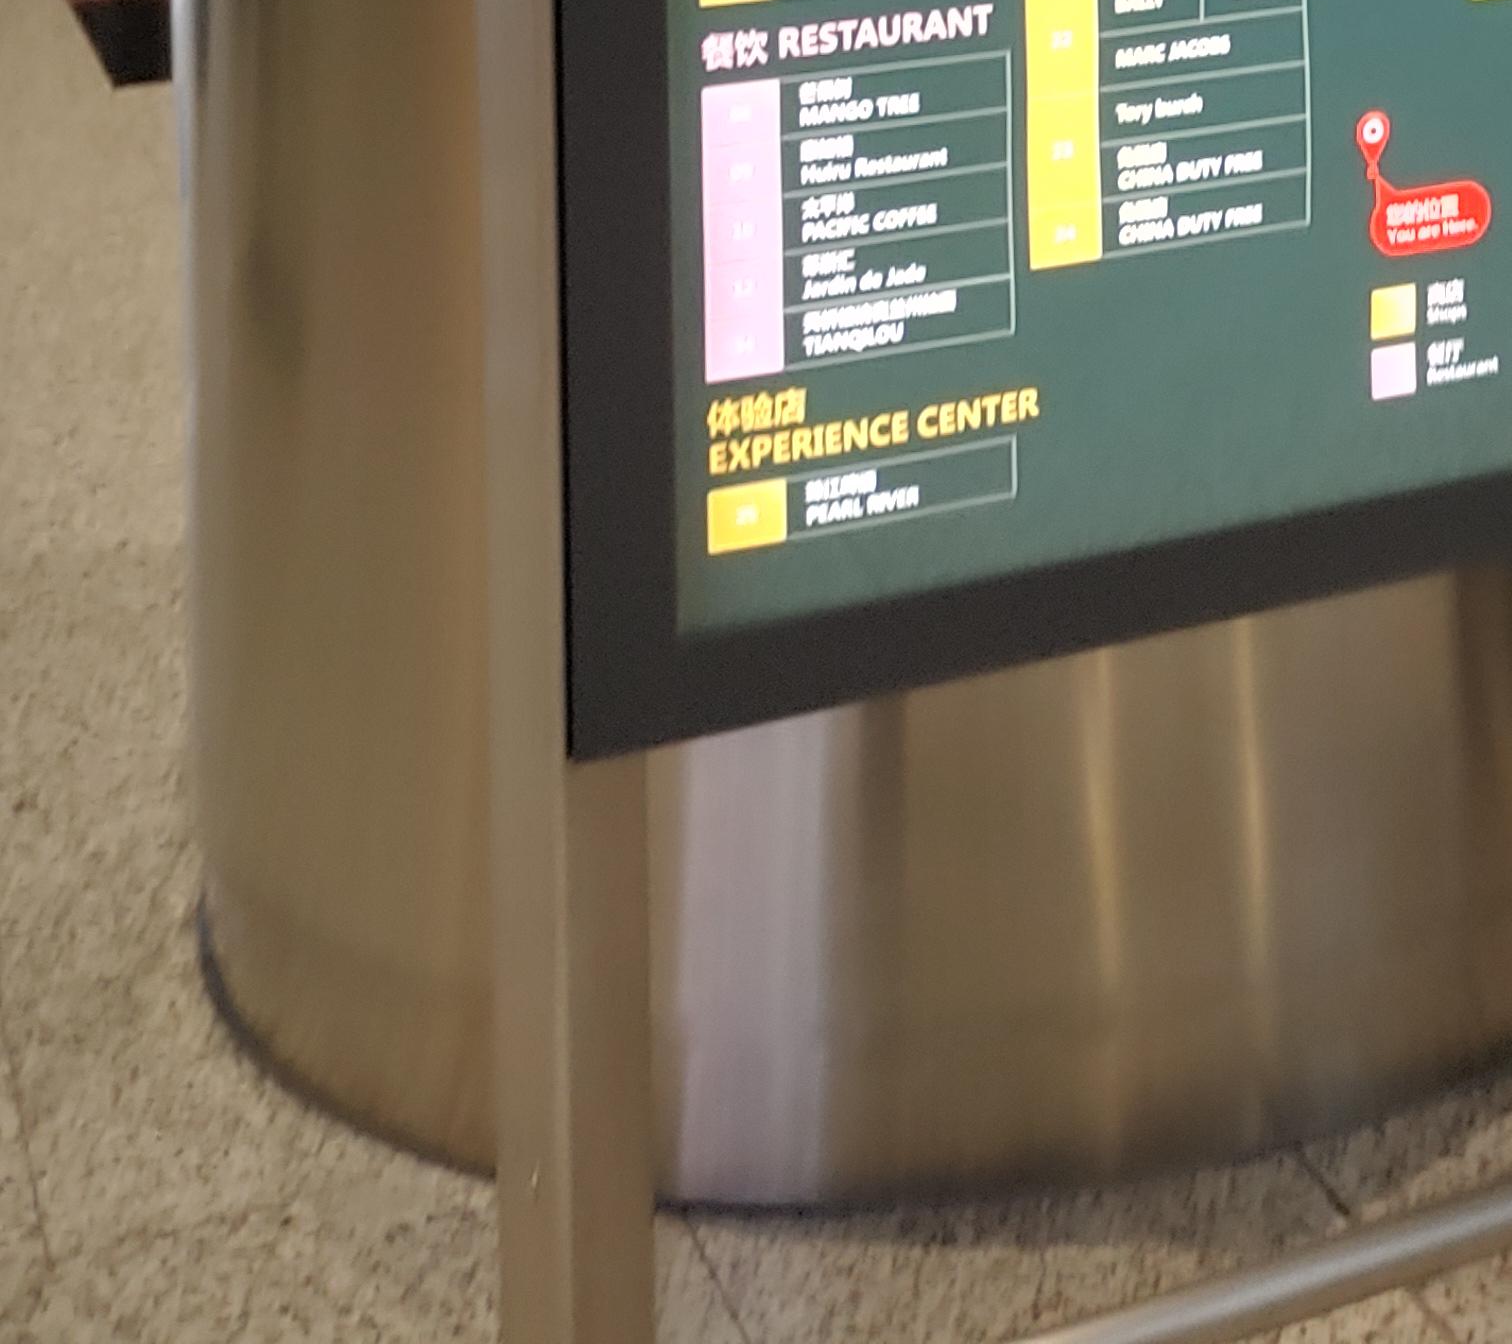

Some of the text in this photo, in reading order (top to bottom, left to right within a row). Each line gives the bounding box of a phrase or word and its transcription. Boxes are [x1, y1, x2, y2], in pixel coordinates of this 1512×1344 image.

[777, 3, 993, 59] RESTAURANT
[1115, 34, 1231, 70] MARC JACOBS
[800, 91, 921, 128] MANGO TREE
[1115, 102, 1154, 126] Tory
[1117, 149, 1263, 192] CHINA DUTY FREE
[801, 202, 939, 244] PACIFIC COFFEE
[1118, 218, 1175, 246] CHINA
[1177, 208, 1223, 237] DUTY
[1224, 202, 1263, 229] FREE
[1386, 227, 1416, 246] You
[1417, 223, 1441, 241] are
[859, 269, 884, 291] de
[706, 385, 808, 439] 体验店
[708, 386, 1040, 476] EXPERIENCE CENTER
[806, 485, 920, 528] PEARL RIVER
